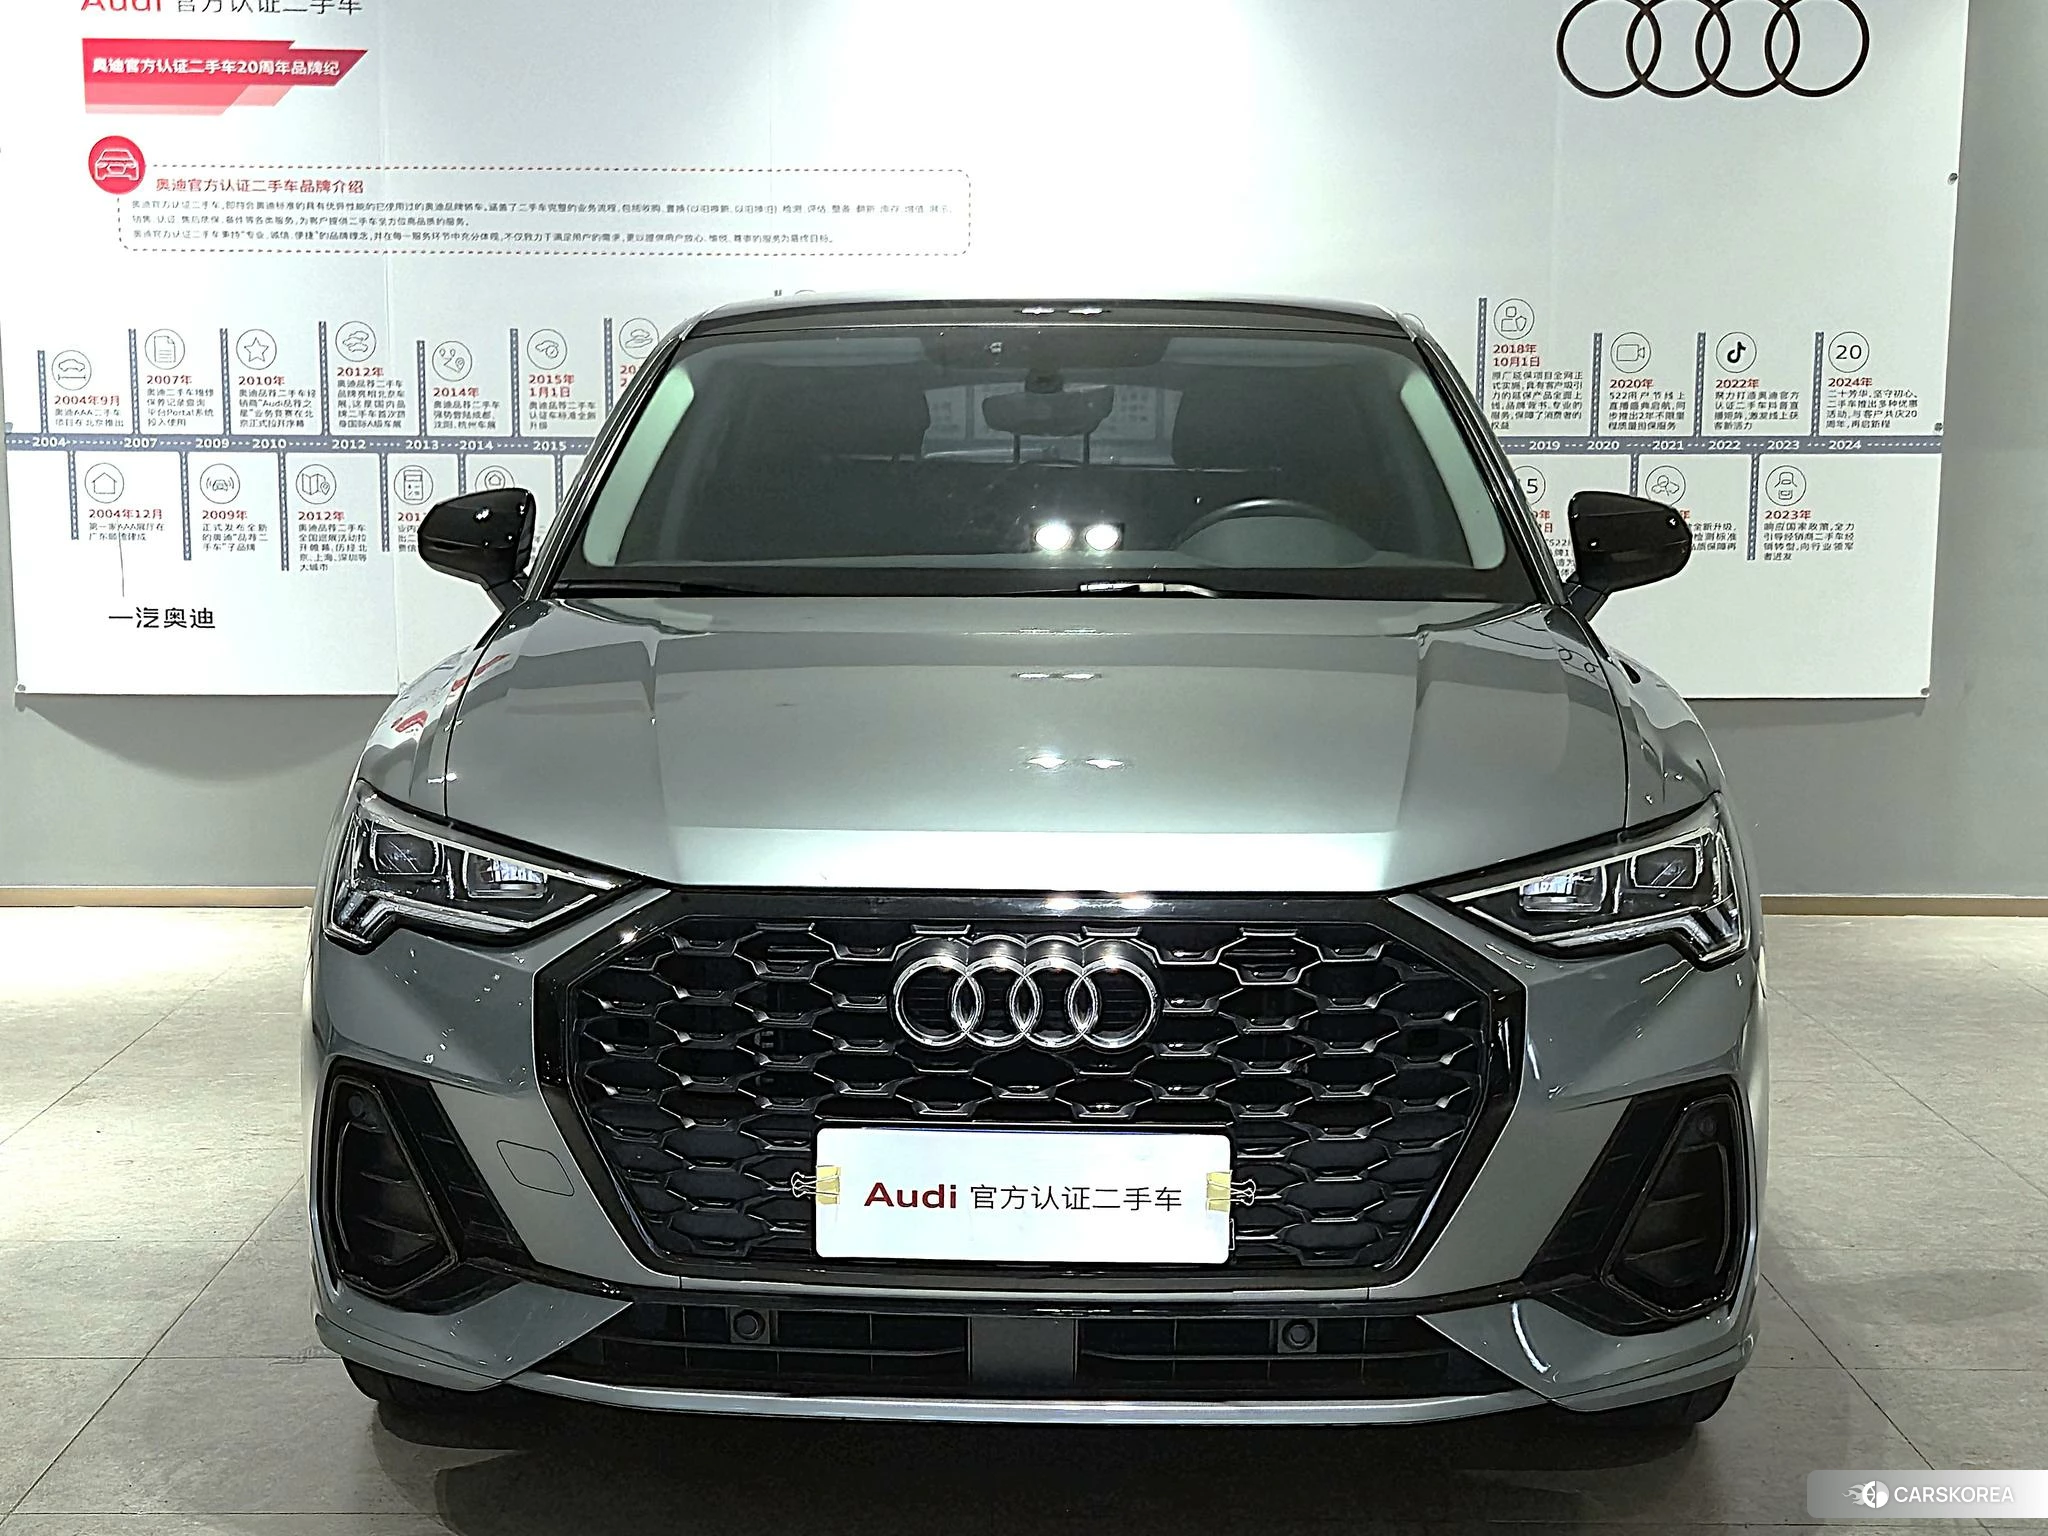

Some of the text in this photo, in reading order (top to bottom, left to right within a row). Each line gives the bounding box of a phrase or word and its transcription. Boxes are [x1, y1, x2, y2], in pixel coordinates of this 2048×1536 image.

[92, 57, 341, 77] 奥迪官方认证二手车20周年品牌纪
[156, 178, 364, 194] 奥迪官方认证二手车品牌介绍
[1493, 344, 1537, 354] 2018年
[1836, 345, 1862, 359] 20
[1493, 357, 1540, 367] 10月1日
[336, 367, 384, 377] 2012年
[146, 375, 192, 385] 2007年
[238, 376, 285, 386] 2010年
[529, 374, 575, 385] 2015年
[1609, 379, 1654, 389] 2020年
[1715, 378, 1760, 388] 2022年
[1827, 377, 1873, 387] 2024年
[433, 387, 480, 397] 2014年
[529, 387, 570, 398] 1月1日
[54, 395, 120, 406] 2004年9月
[32, 437, 1862, 451] 2004 2007 2009 2010 2012 2013 2014 2015 2019 2020 2021 2022 2023 2024
[89, 509, 162, 520] 2004年12月
[202, 510, 248, 520] 2009年
[298, 512, 345, 522] 2012年
[1764, 510, 1811, 520] 2023年
[109, 607, 216, 629] 一汽奥迪
[864, 1182, 1183, 1211] Audi 官方认证二手车
